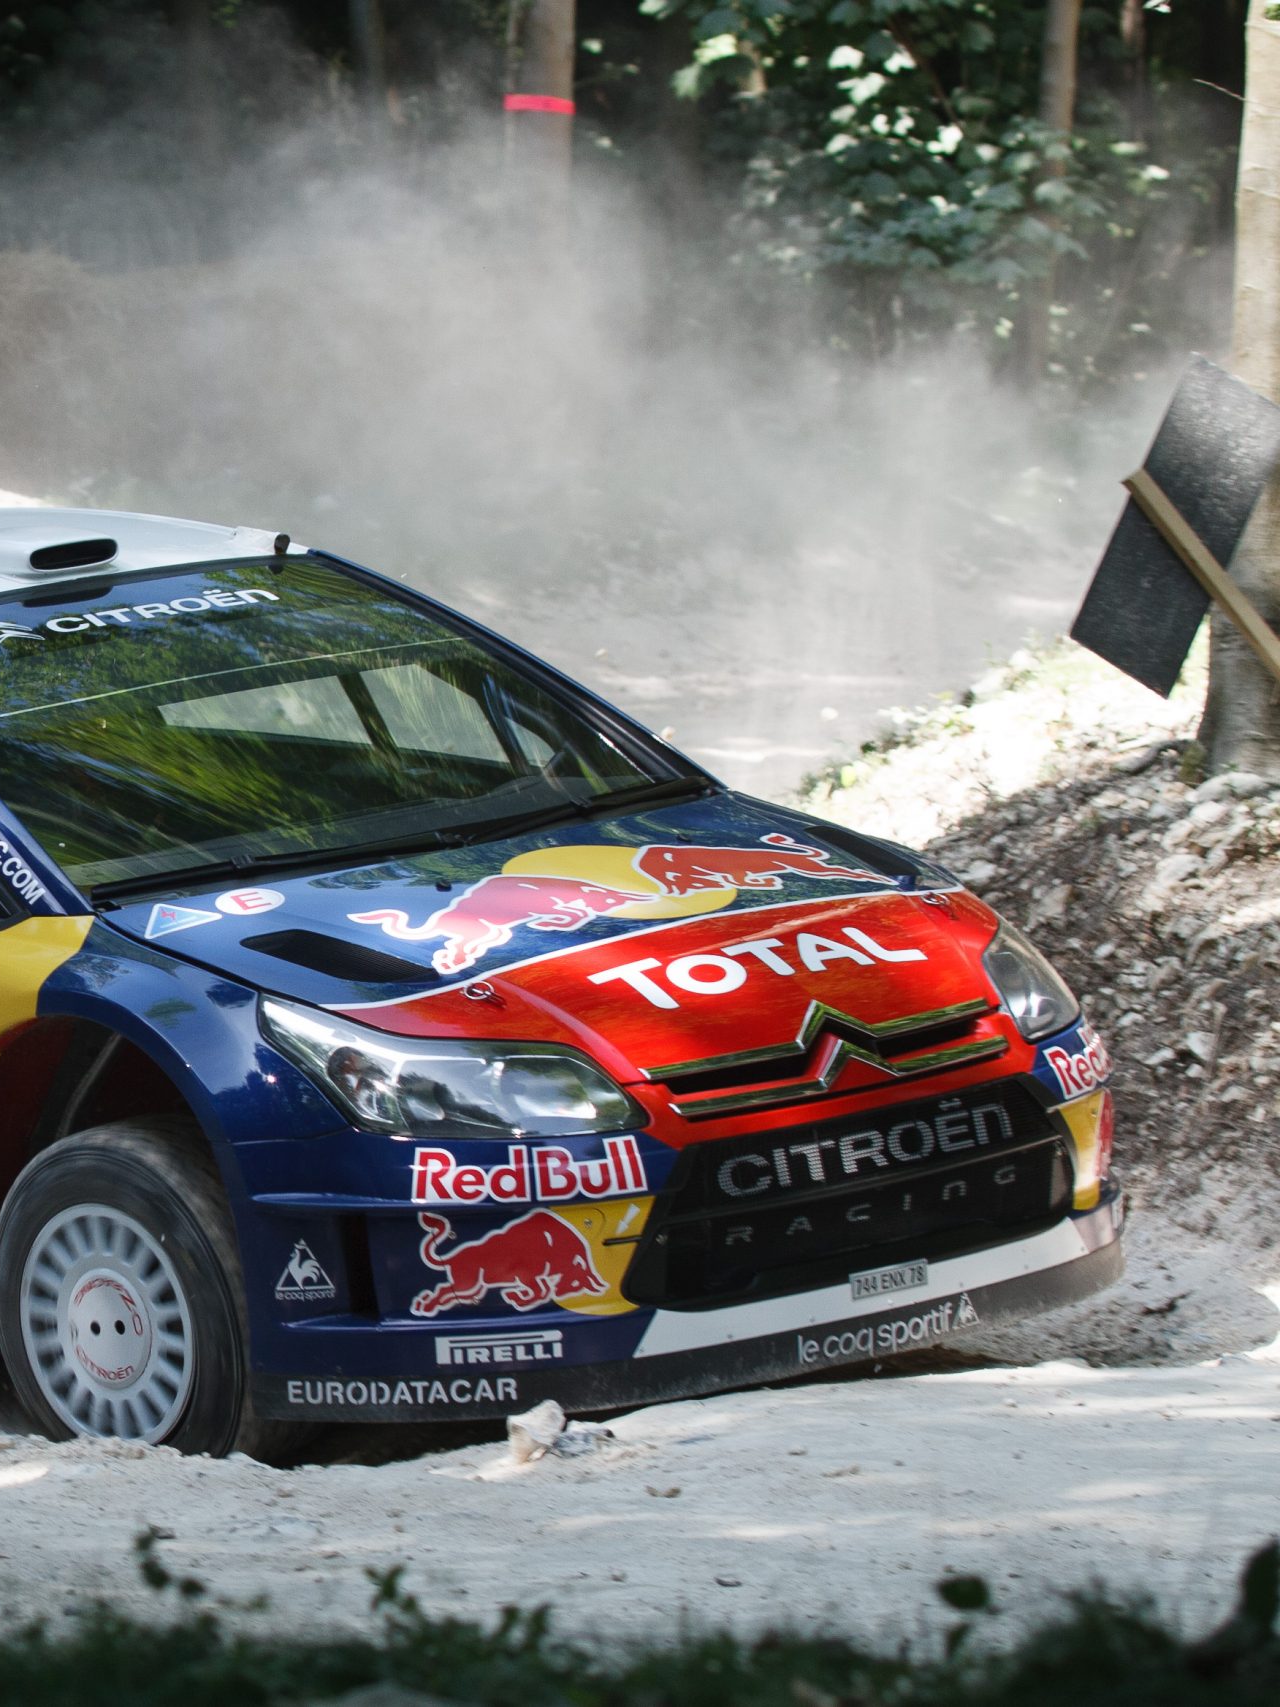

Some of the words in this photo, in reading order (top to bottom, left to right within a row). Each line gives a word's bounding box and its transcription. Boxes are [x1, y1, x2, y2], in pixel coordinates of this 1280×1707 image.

[46, 588, 280, 633] CITROËN
[588, 926, 928, 1011] TOTAL
[411, 1144, 533, 1203] Red
[534, 1134, 649, 1202] Bull
[716, 1098, 1015, 1197] CITROËN
[724, 1164, 1017, 1245] RACING
[854, 1276, 879, 1296] 744
[880, 1268, 907, 1291] ENX
[435, 1330, 564, 1365] PIRELLI
[797, 1334, 820, 1364] le
[822, 1326, 875, 1359] coq
[876, 1301, 953, 1353] sportif
[287, 1377, 518, 1405] EURODATACAR
